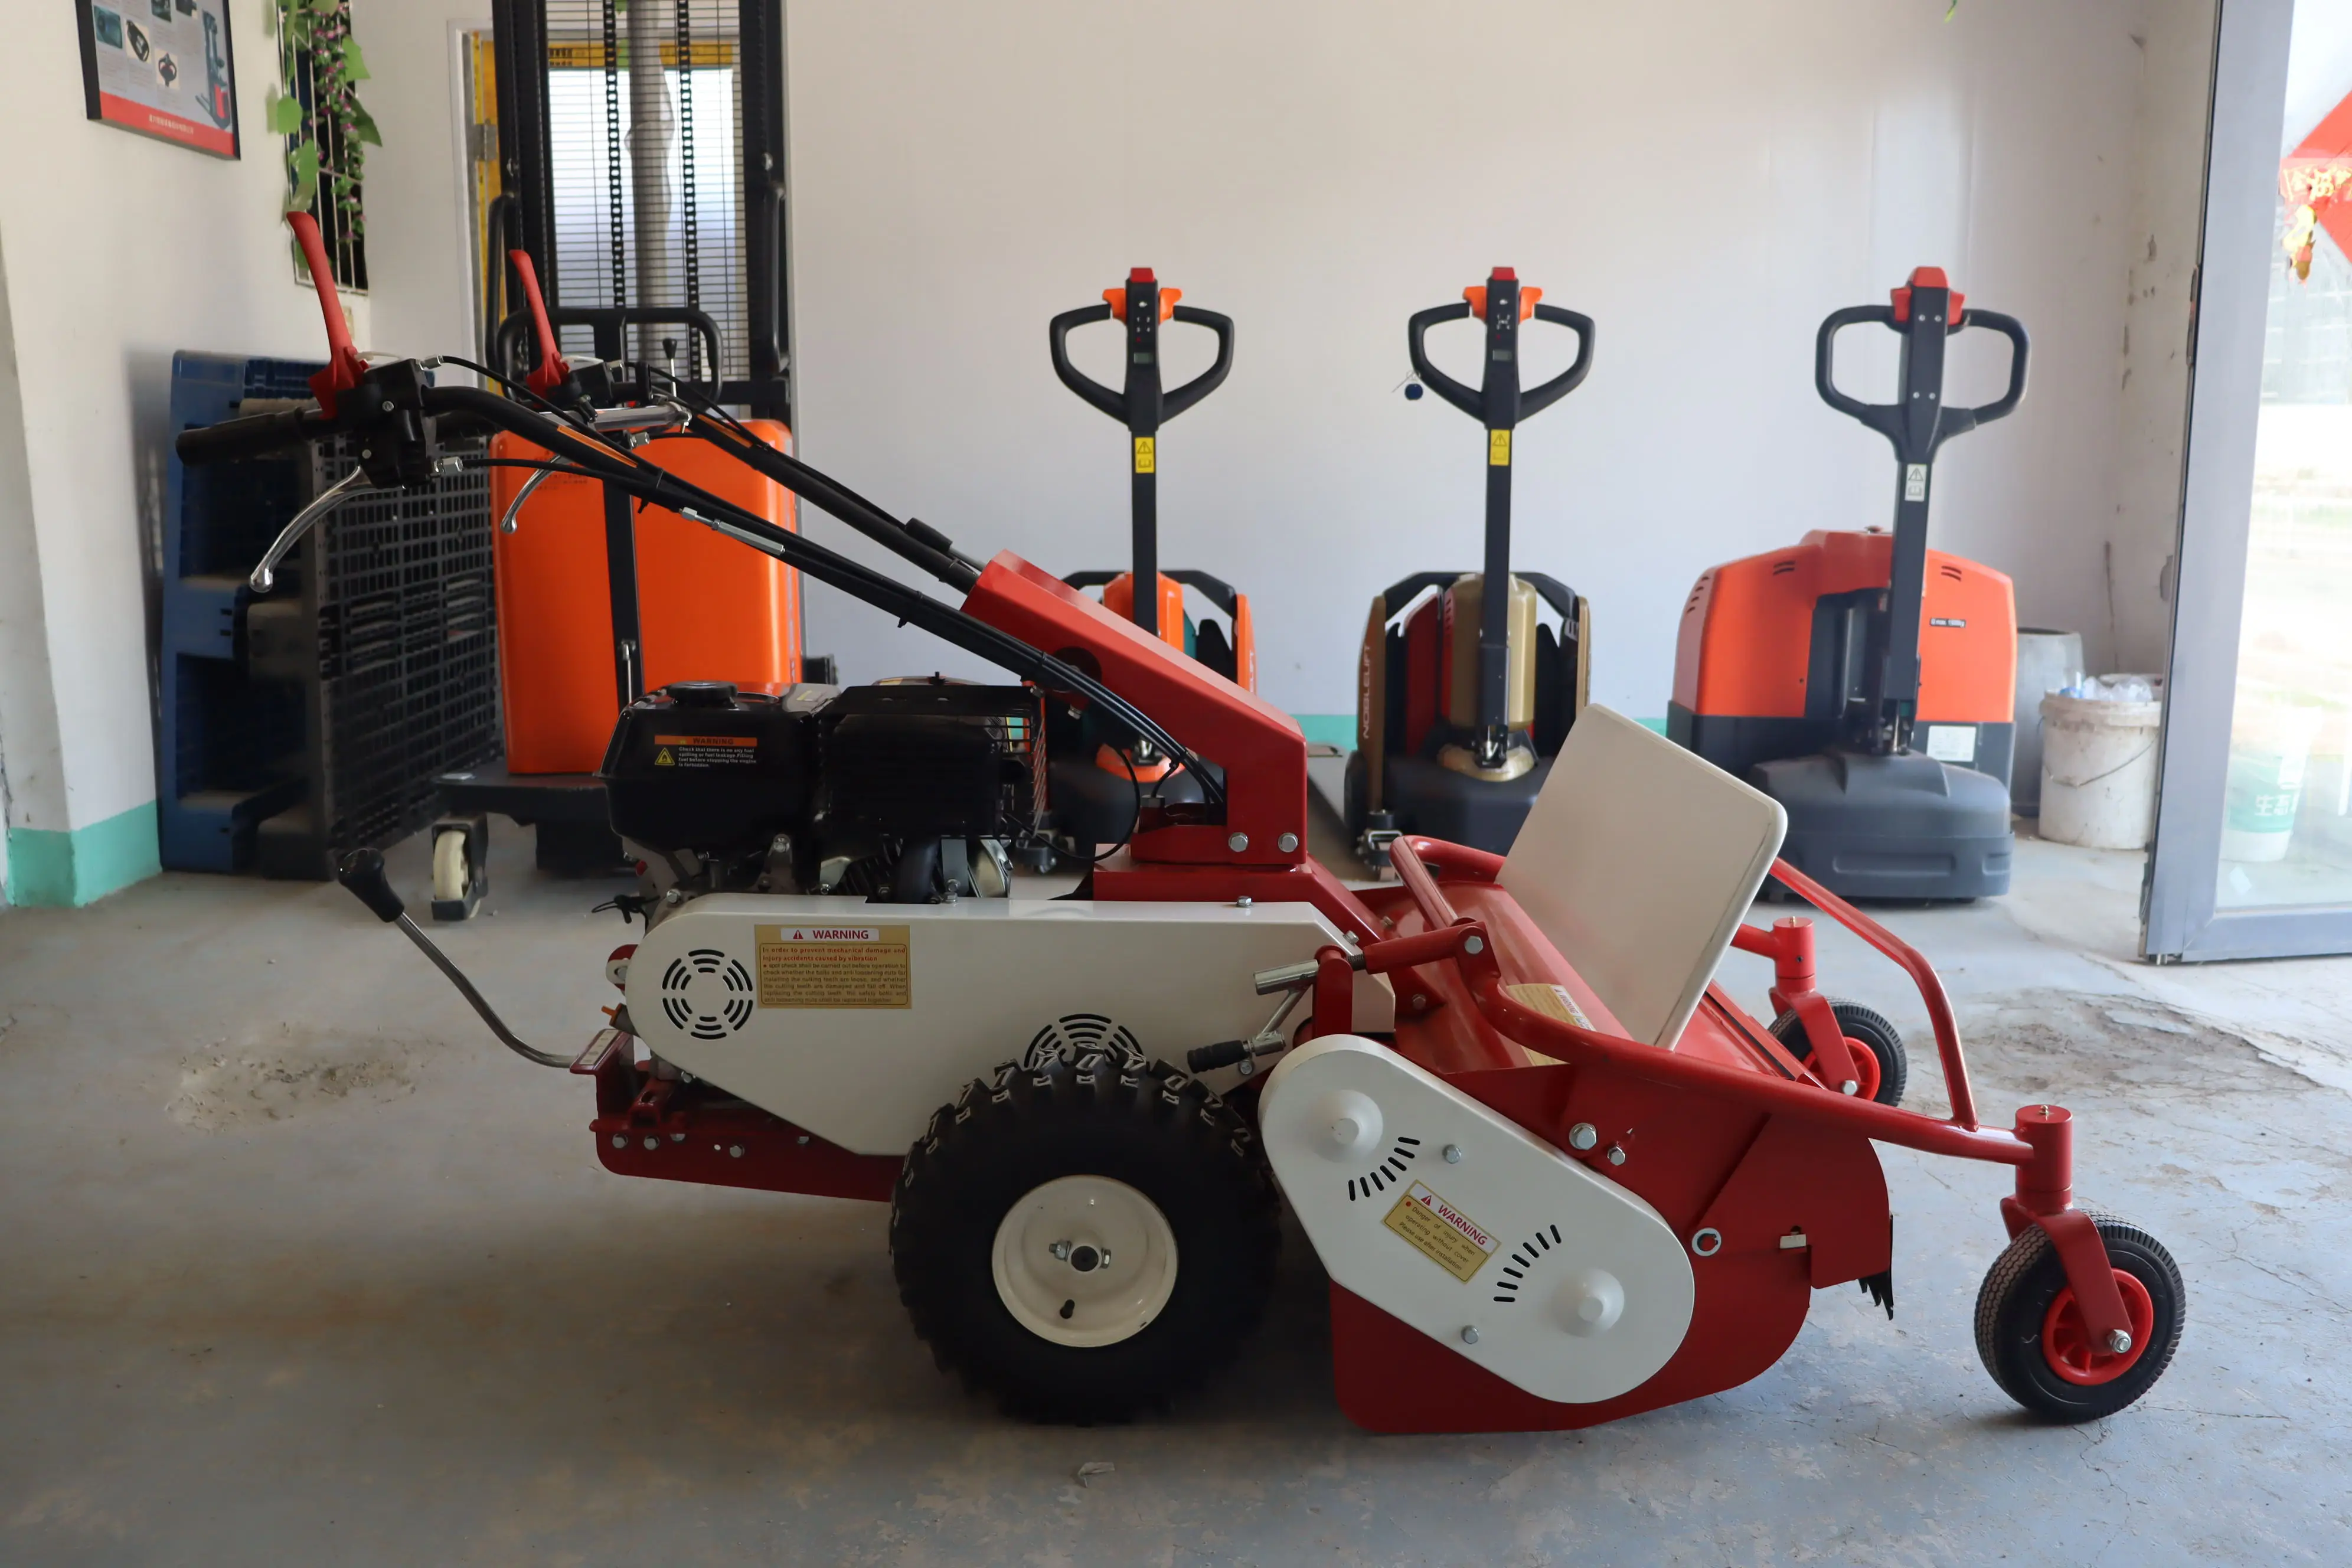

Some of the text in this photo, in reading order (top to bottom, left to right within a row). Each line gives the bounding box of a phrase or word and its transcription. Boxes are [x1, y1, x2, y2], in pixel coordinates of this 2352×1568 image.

[812, 930, 869, 939] WARNING
[1399, 1221, 1462, 1270] Please use after installation
[1405, 1215, 1469, 1263] operating without cover
[1412, 1206, 1431, 1223] Danger
[1443, 1231, 1458, 1243] injury
[1461, 1244, 1475, 1256] when
[1438, 1204, 1488, 1245] WARNING
